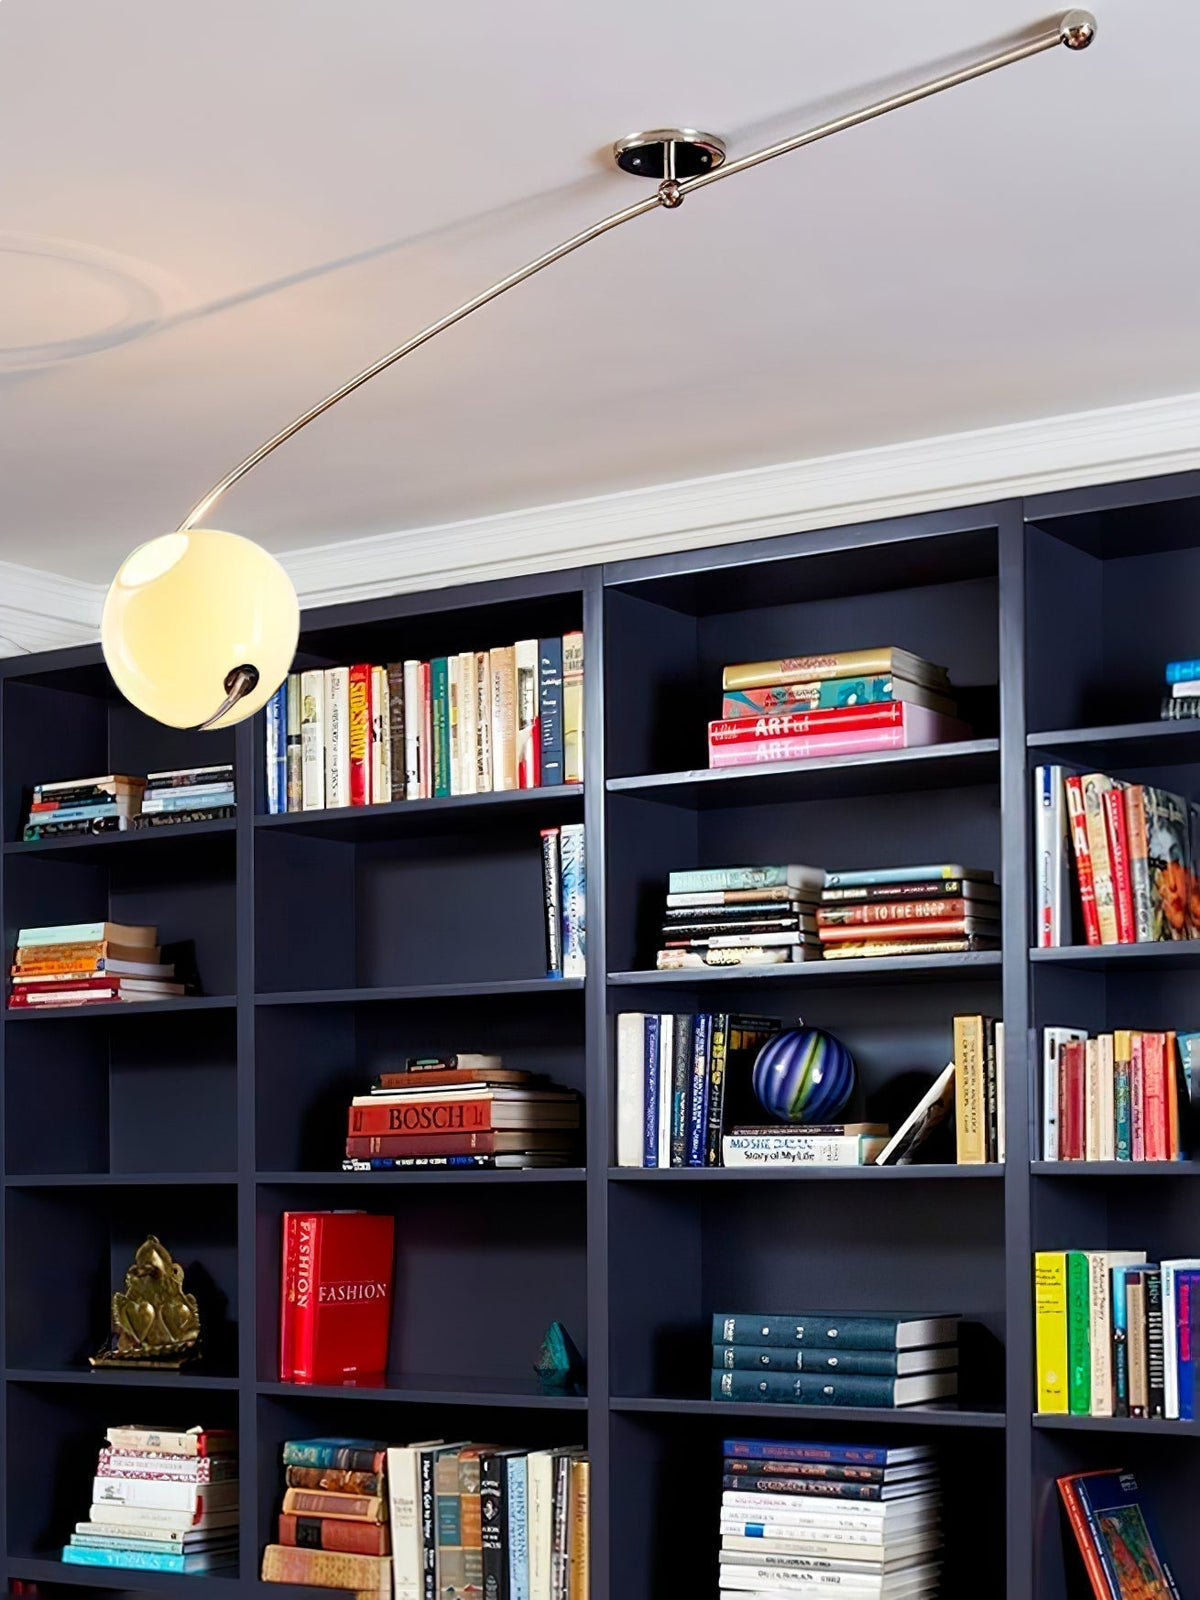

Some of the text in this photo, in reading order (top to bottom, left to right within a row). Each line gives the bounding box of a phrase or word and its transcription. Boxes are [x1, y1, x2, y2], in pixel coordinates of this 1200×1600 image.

[755, 716, 793, 737] ART
[874, 902, 945, 920] TO THE HOOP
[388, 1104, 464, 1131] BOSCH
[297, 1220, 312, 1309] FASHION
[319, 1283, 387, 1302] FASHION
